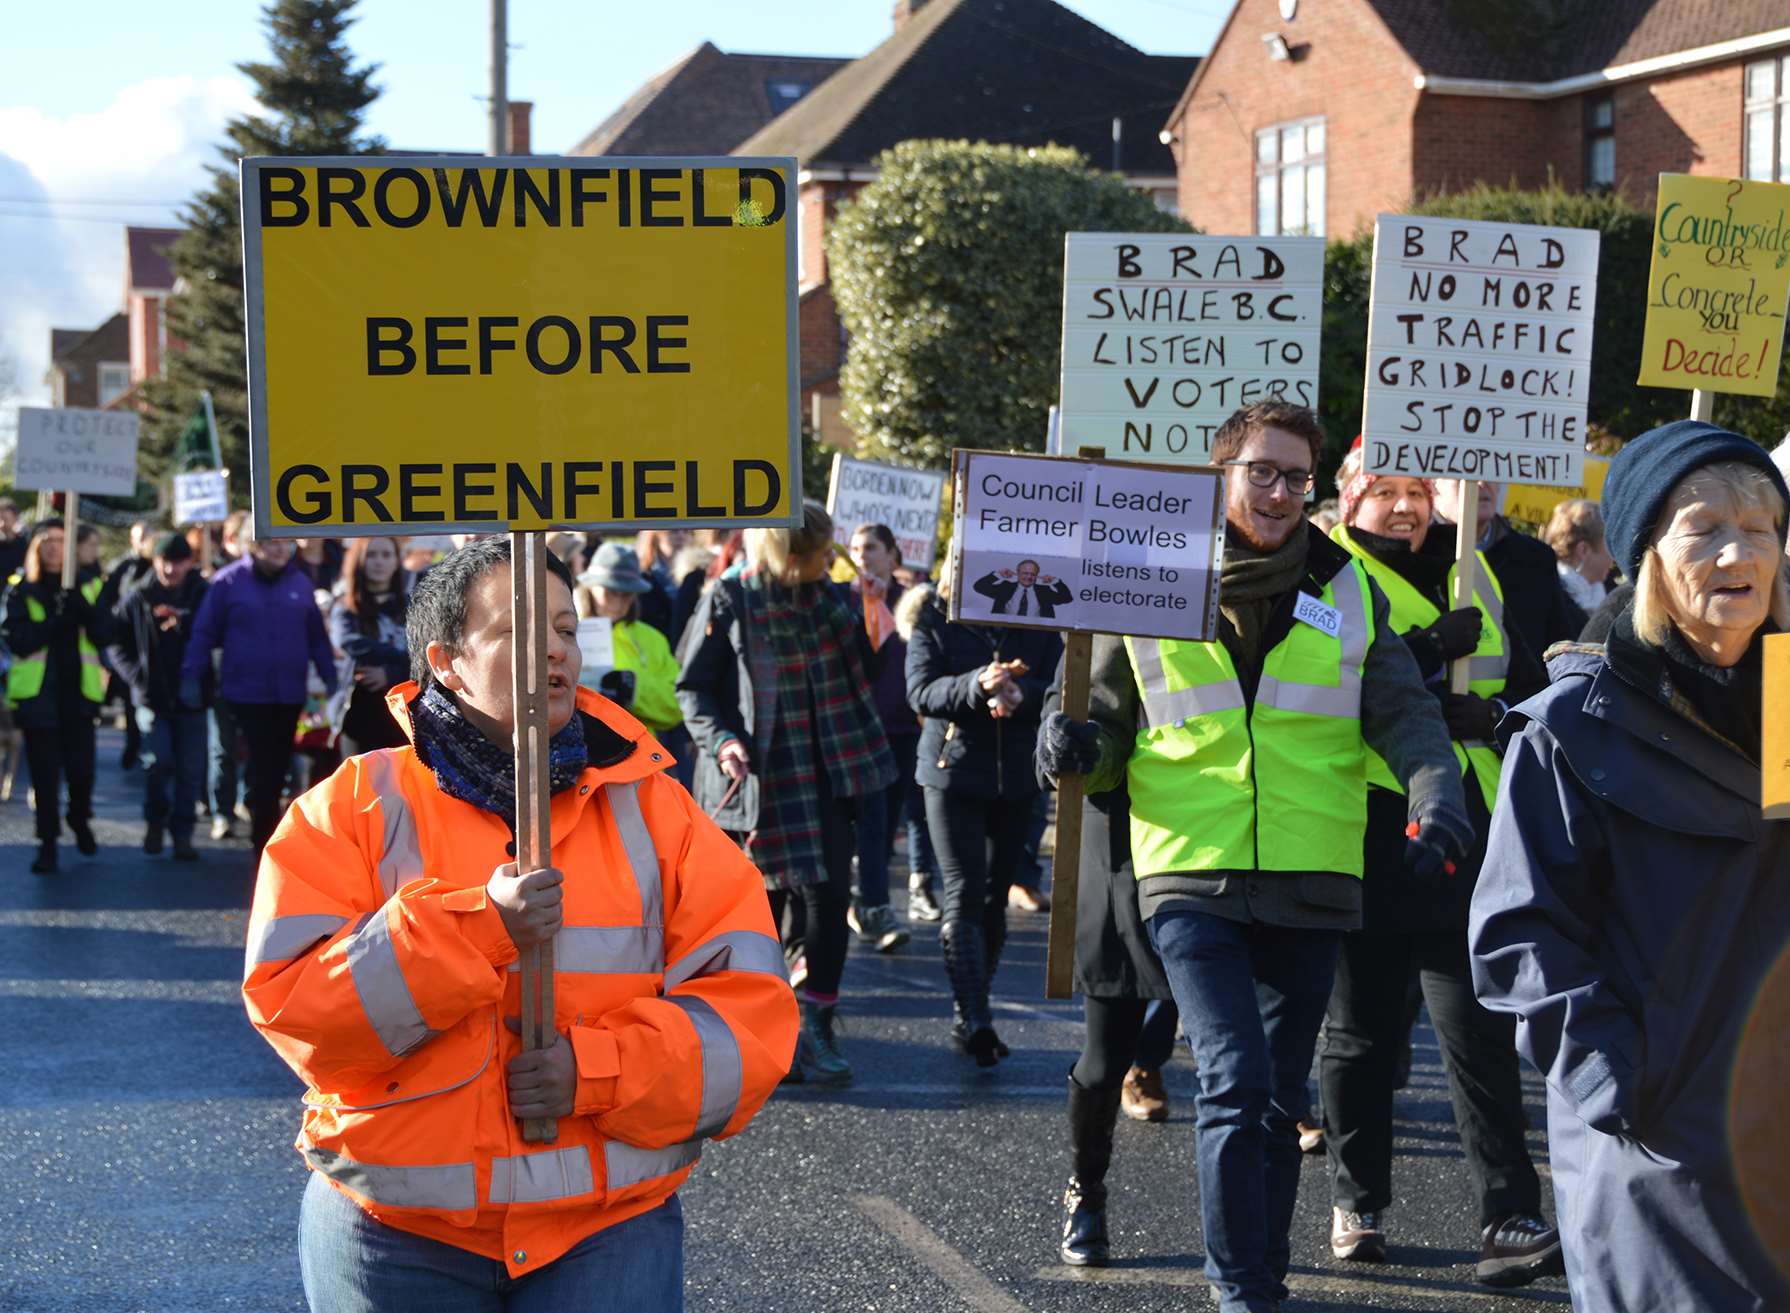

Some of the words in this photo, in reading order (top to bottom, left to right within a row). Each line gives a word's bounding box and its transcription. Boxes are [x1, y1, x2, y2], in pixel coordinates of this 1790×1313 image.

[259, 167, 786, 228] BROWNFIELD
[1114, 244, 1284, 280] BRAD
[1404, 226, 1564, 269] BRAD
[1706, 247, 1745, 265] OR
[1087, 288, 1219, 322] SWALE
[1409, 272, 1456, 301] NO
[1482, 277, 1581, 311] MORE
[1662, 273, 1768, 316] Concrete
[366, 315, 691, 376] BEFORE
[1093, 333, 1225, 366] LISTEN
[1255, 339, 1303, 365] TO
[1397, 314, 1575, 354] TRAFFIC
[1379, 357, 1574, 397] GRIDLOCK!
[1662, 337, 1769, 379] Decide!
[1124, 377, 1312, 408] VOTERS
[1123, 421, 1218, 453] NOT
[1401, 401, 1505, 436] STOP
[1516, 412, 1576, 441] THE
[1371, 441, 1570, 480] DEVELOPMENT!
[276, 459, 781, 524] GREENFIELD
[982, 474, 1083, 503] Council
[1096, 484, 1192, 514] Leader
[980, 509, 1079, 537] Farmer
[1090, 520, 1187, 549] Bowles
[1082, 559, 1150, 580] listens
[1160, 566, 1178, 582] to
[1080, 587, 1187, 610] electorate
[1300, 605, 1336, 629] BRAD
